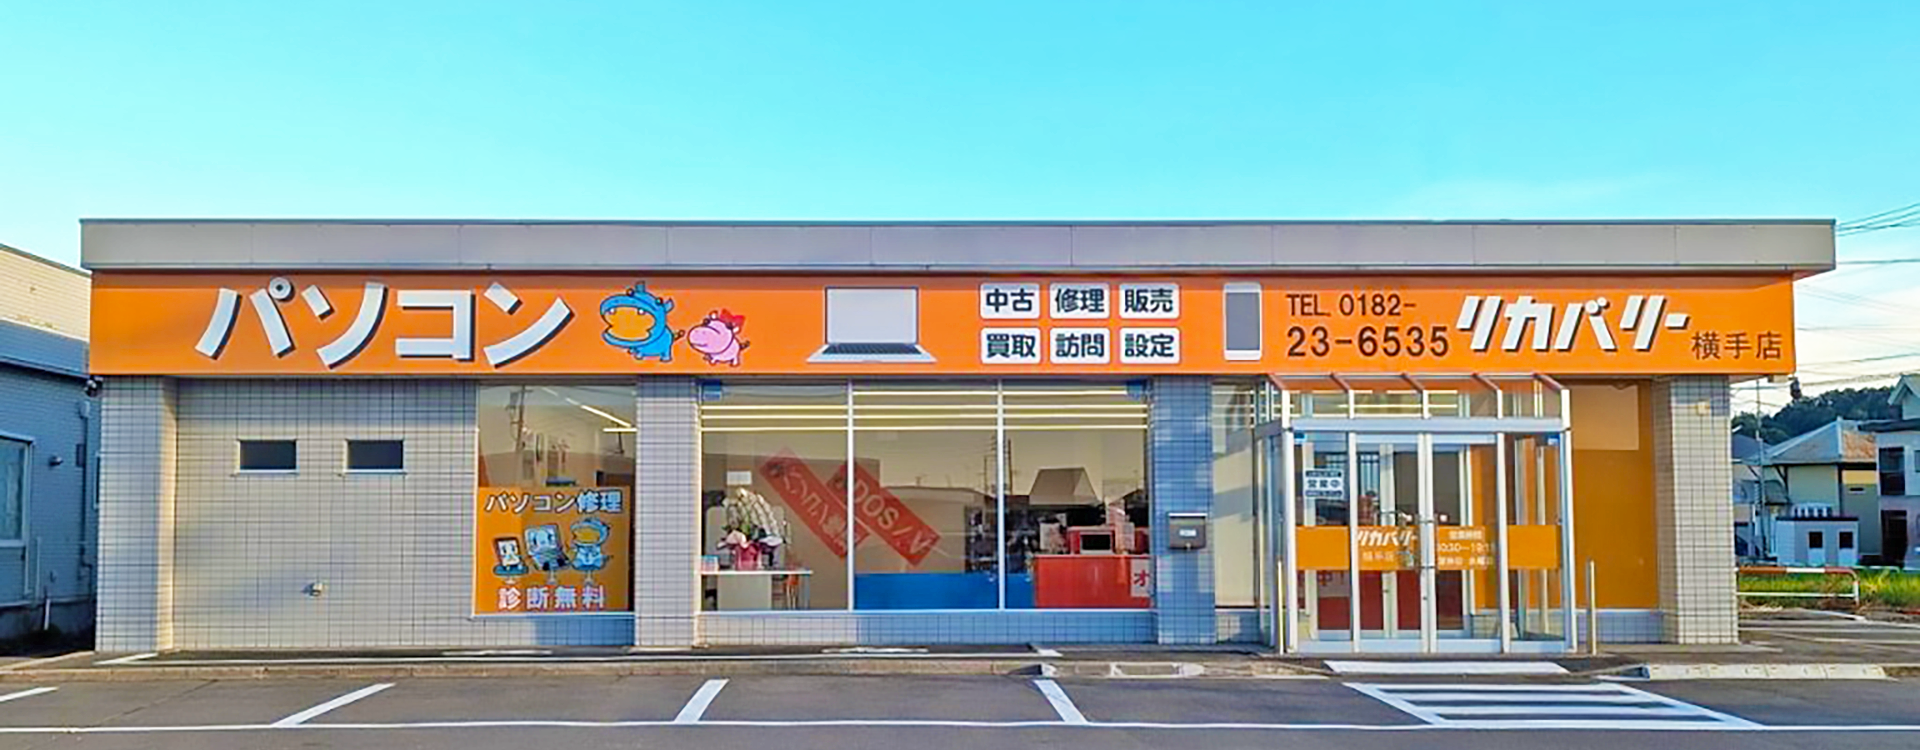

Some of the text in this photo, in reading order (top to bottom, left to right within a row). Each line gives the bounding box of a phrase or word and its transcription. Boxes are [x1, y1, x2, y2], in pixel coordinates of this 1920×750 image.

[985, 287, 1174, 313] 中古 修理 販売
[1339, 293, 1416, 317] 0182-
[194, 276, 575, 369] パソコン
[1455, 294, 1690, 352] リカバリー
[986, 333, 1175, 358] 買取 訪問 設定
[1286, 326, 1449, 357] 23-6535
[1691, 331, 1783, 360] 横手店
[485, 489, 623, 513] パソコン修理
[498, 585, 605, 609] 診断無料
